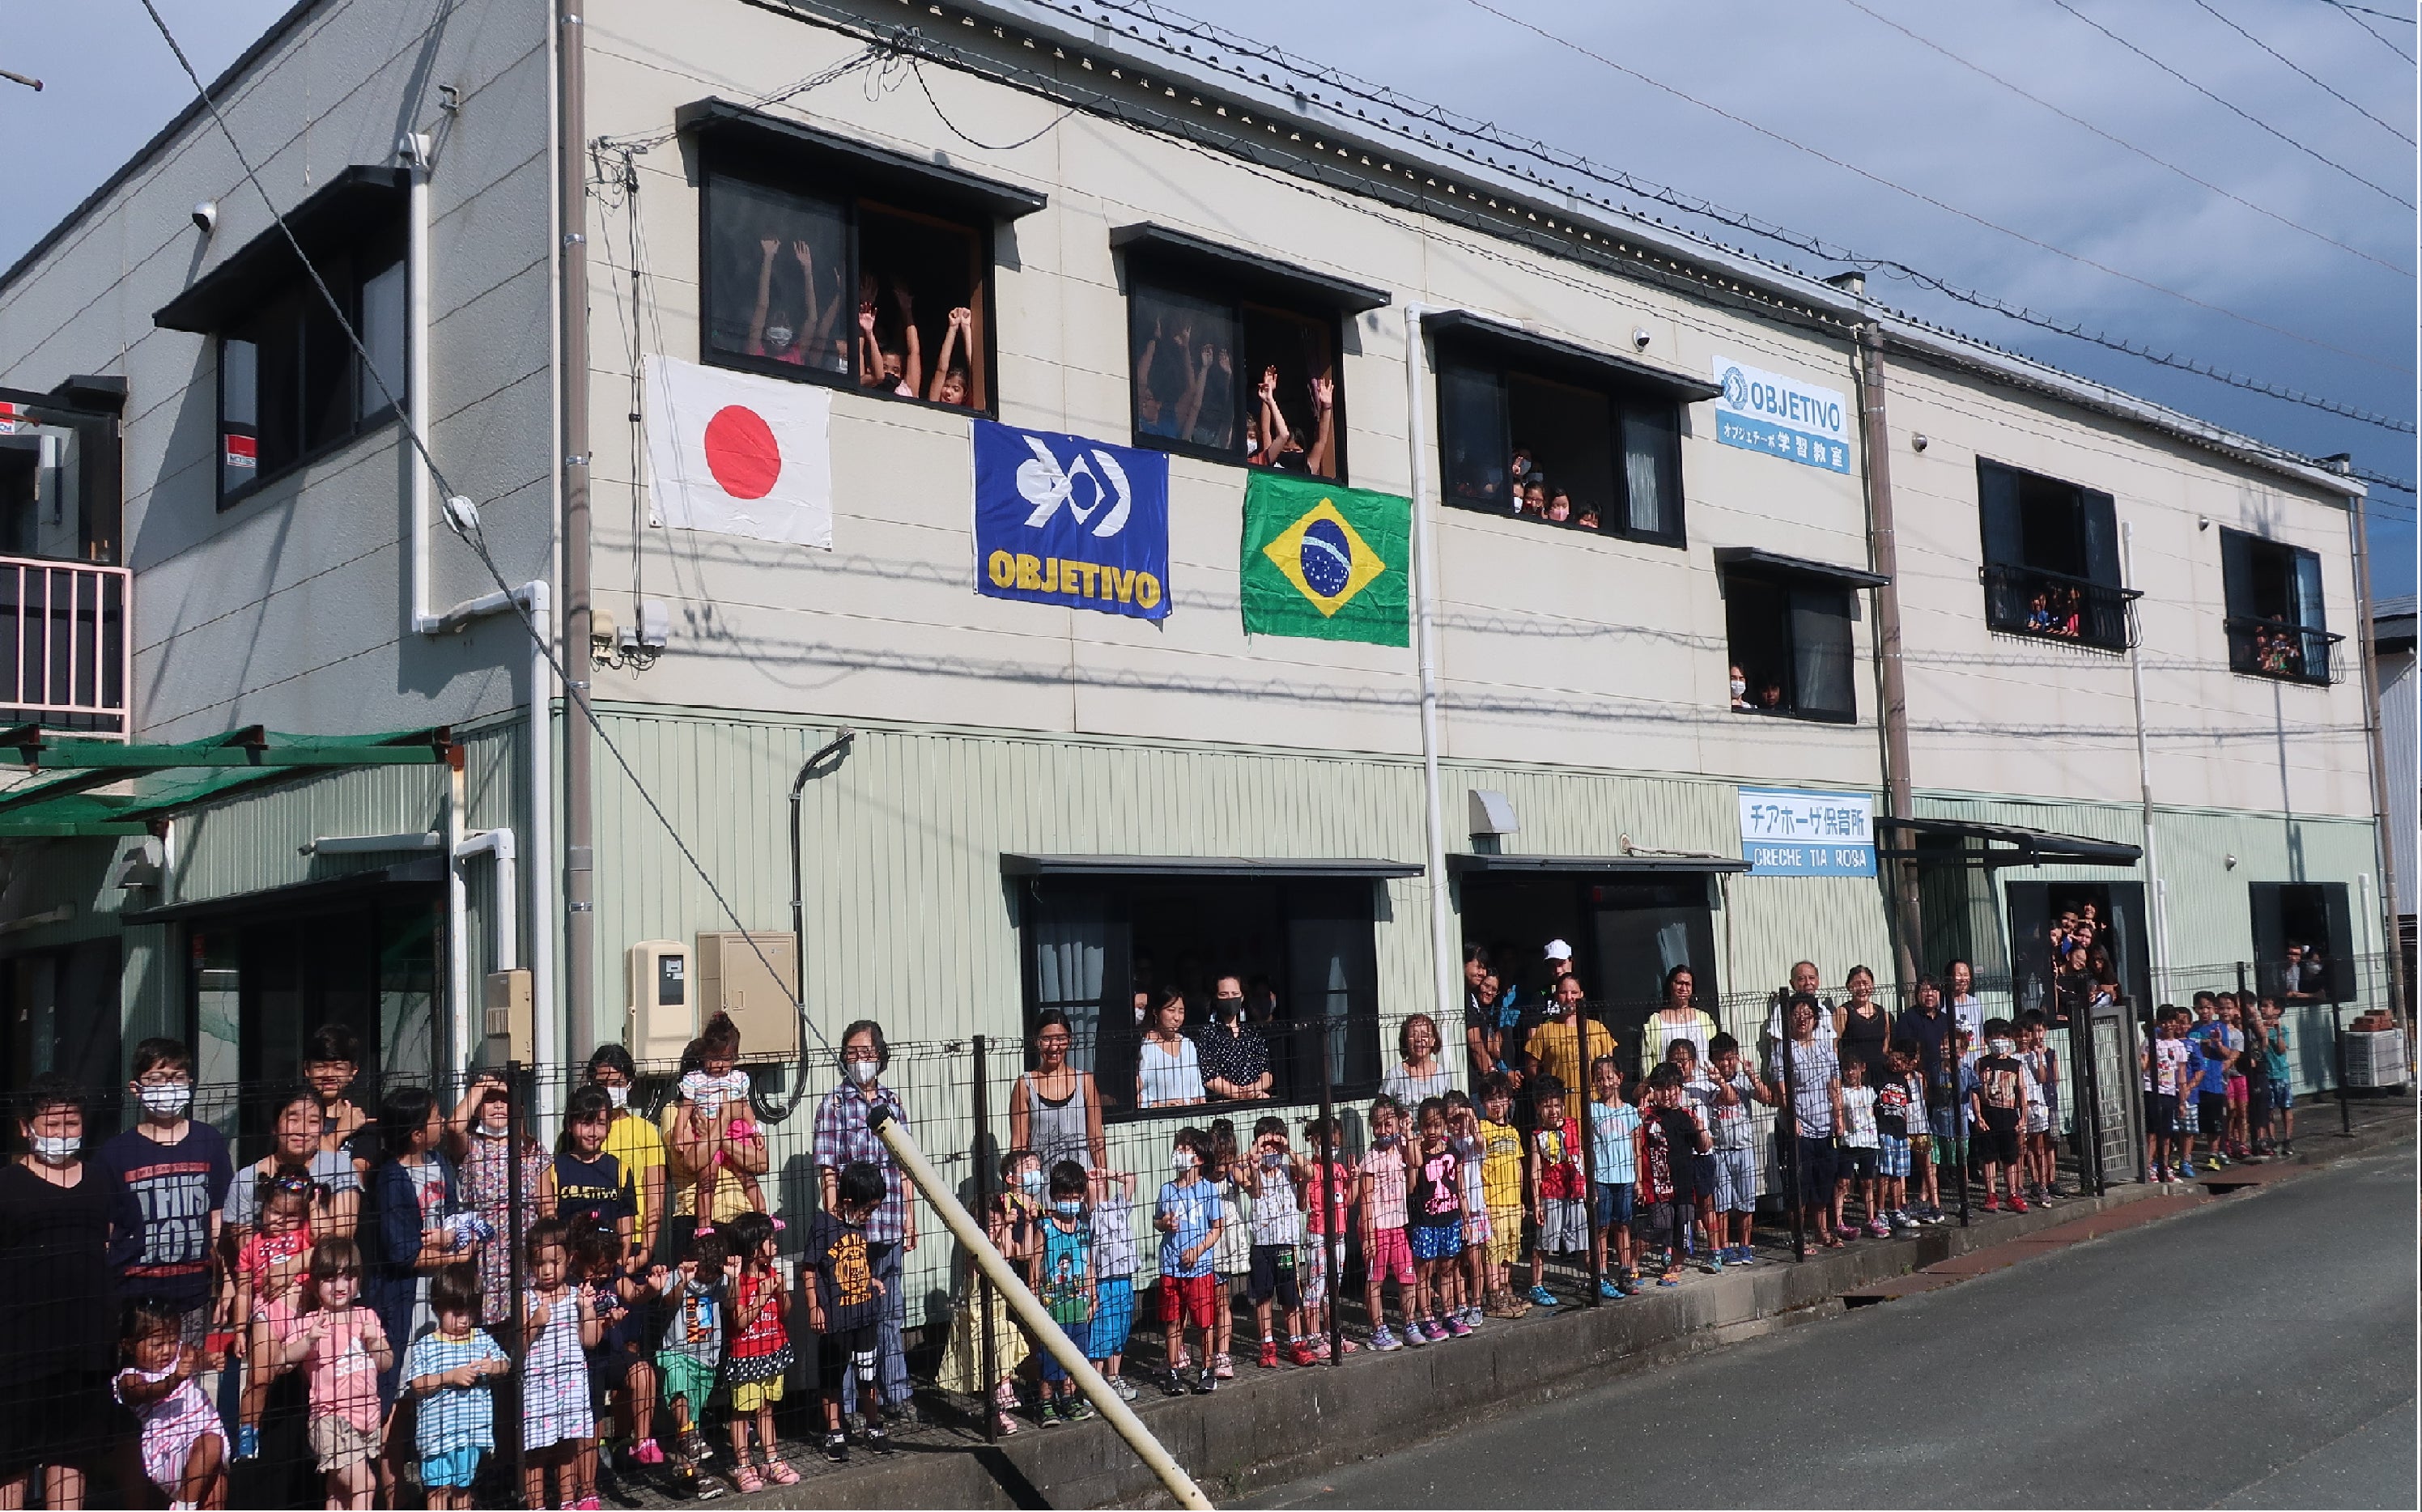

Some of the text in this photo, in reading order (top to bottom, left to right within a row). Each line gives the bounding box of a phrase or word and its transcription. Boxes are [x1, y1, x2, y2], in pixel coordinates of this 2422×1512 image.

[1751, 381, 1840, 432] OBJETIVO
[988, 550, 1162, 609] OBJETIVO
[1750, 804, 1865, 836] チアホーザ保育所
[1753, 847, 1867, 868] CRECHE TIA ROSA
[130, 1173, 210, 1221] THIS
